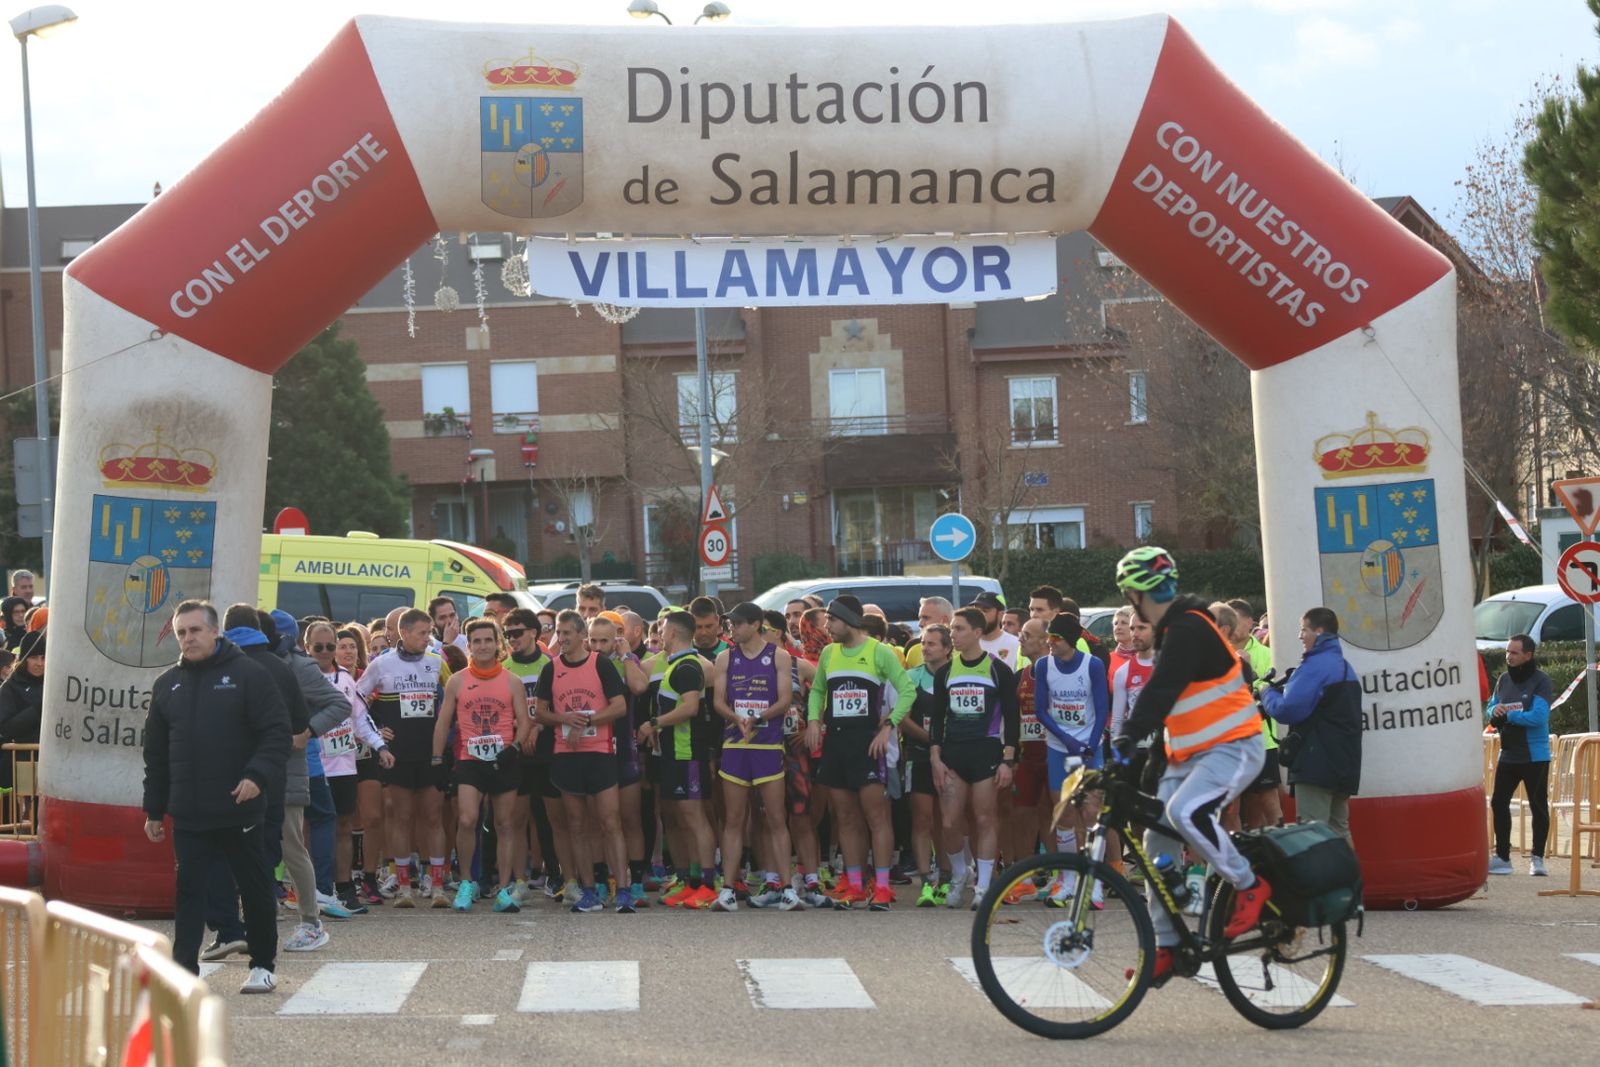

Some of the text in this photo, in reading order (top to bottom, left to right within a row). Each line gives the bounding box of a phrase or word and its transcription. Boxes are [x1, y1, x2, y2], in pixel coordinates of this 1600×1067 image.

[626, 65, 989, 139] Diputación
[623, 150, 1056, 206] de Salamanca
[1155, 121, 1369, 304] CON NUESTROS
[169, 132, 388, 319] CON EL DEPORTE
[1132, 163, 1326, 327] DEPORTISTAS
[567, 245, 1012, 299] VILLAMAYOR
[707, 538, 725, 553] 30
[294, 560, 412, 578] AMBULANCIA
[410, 700, 426, 711] 95
[839, 698, 862, 710] 169
[956, 695, 978, 707] 168
[1058, 710, 1080, 721] 186
[55, 716, 72, 740] de
[1024, 723, 1041, 735] 148
[331, 734, 350, 749] 112
[474, 743, 498, 756] 191
